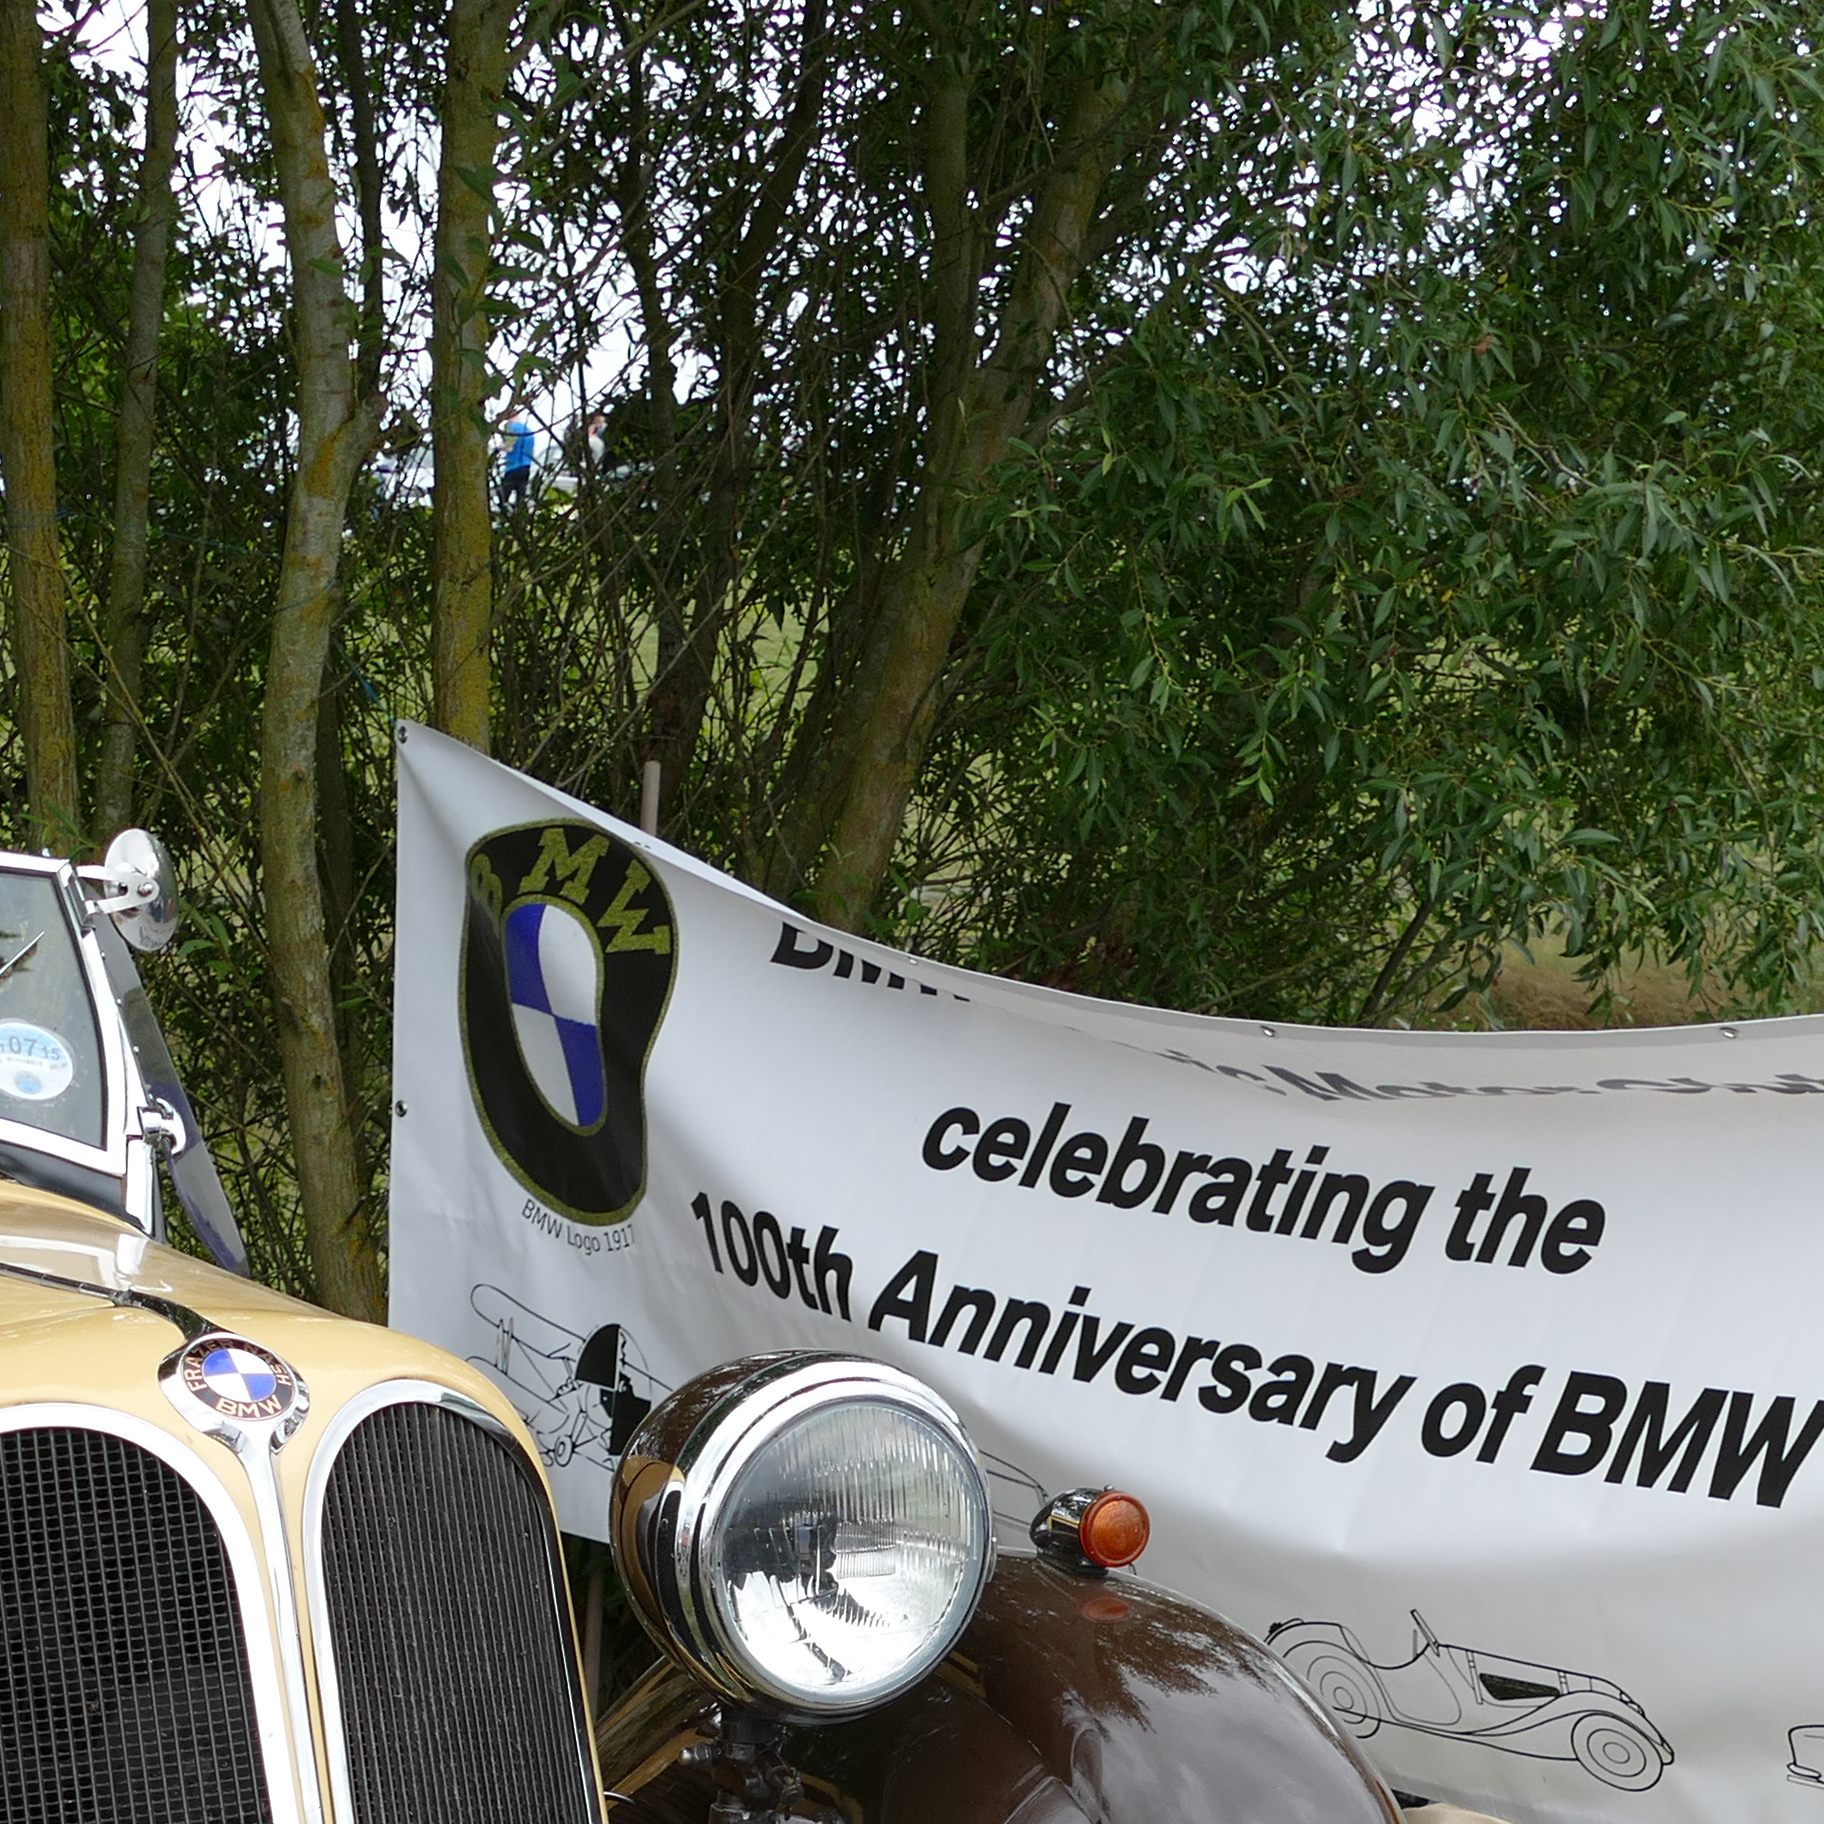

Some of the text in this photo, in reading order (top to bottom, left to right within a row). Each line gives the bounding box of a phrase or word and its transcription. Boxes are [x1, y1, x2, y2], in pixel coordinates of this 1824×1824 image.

[470, 827, 672, 956] BMW
[521, 1198, 637, 1256] BMW Logo 1917
[922, 1102, 1606, 1275] celebrating the
[184, 1339, 292, 1392] FRAZER NASH
[690, 1191, 854, 1322] 100th
[867, 1250, 1381, 1463] Anniversary
[1421, 1363, 1546, 1464] of
[215, 1394, 282, 1419] BMW
